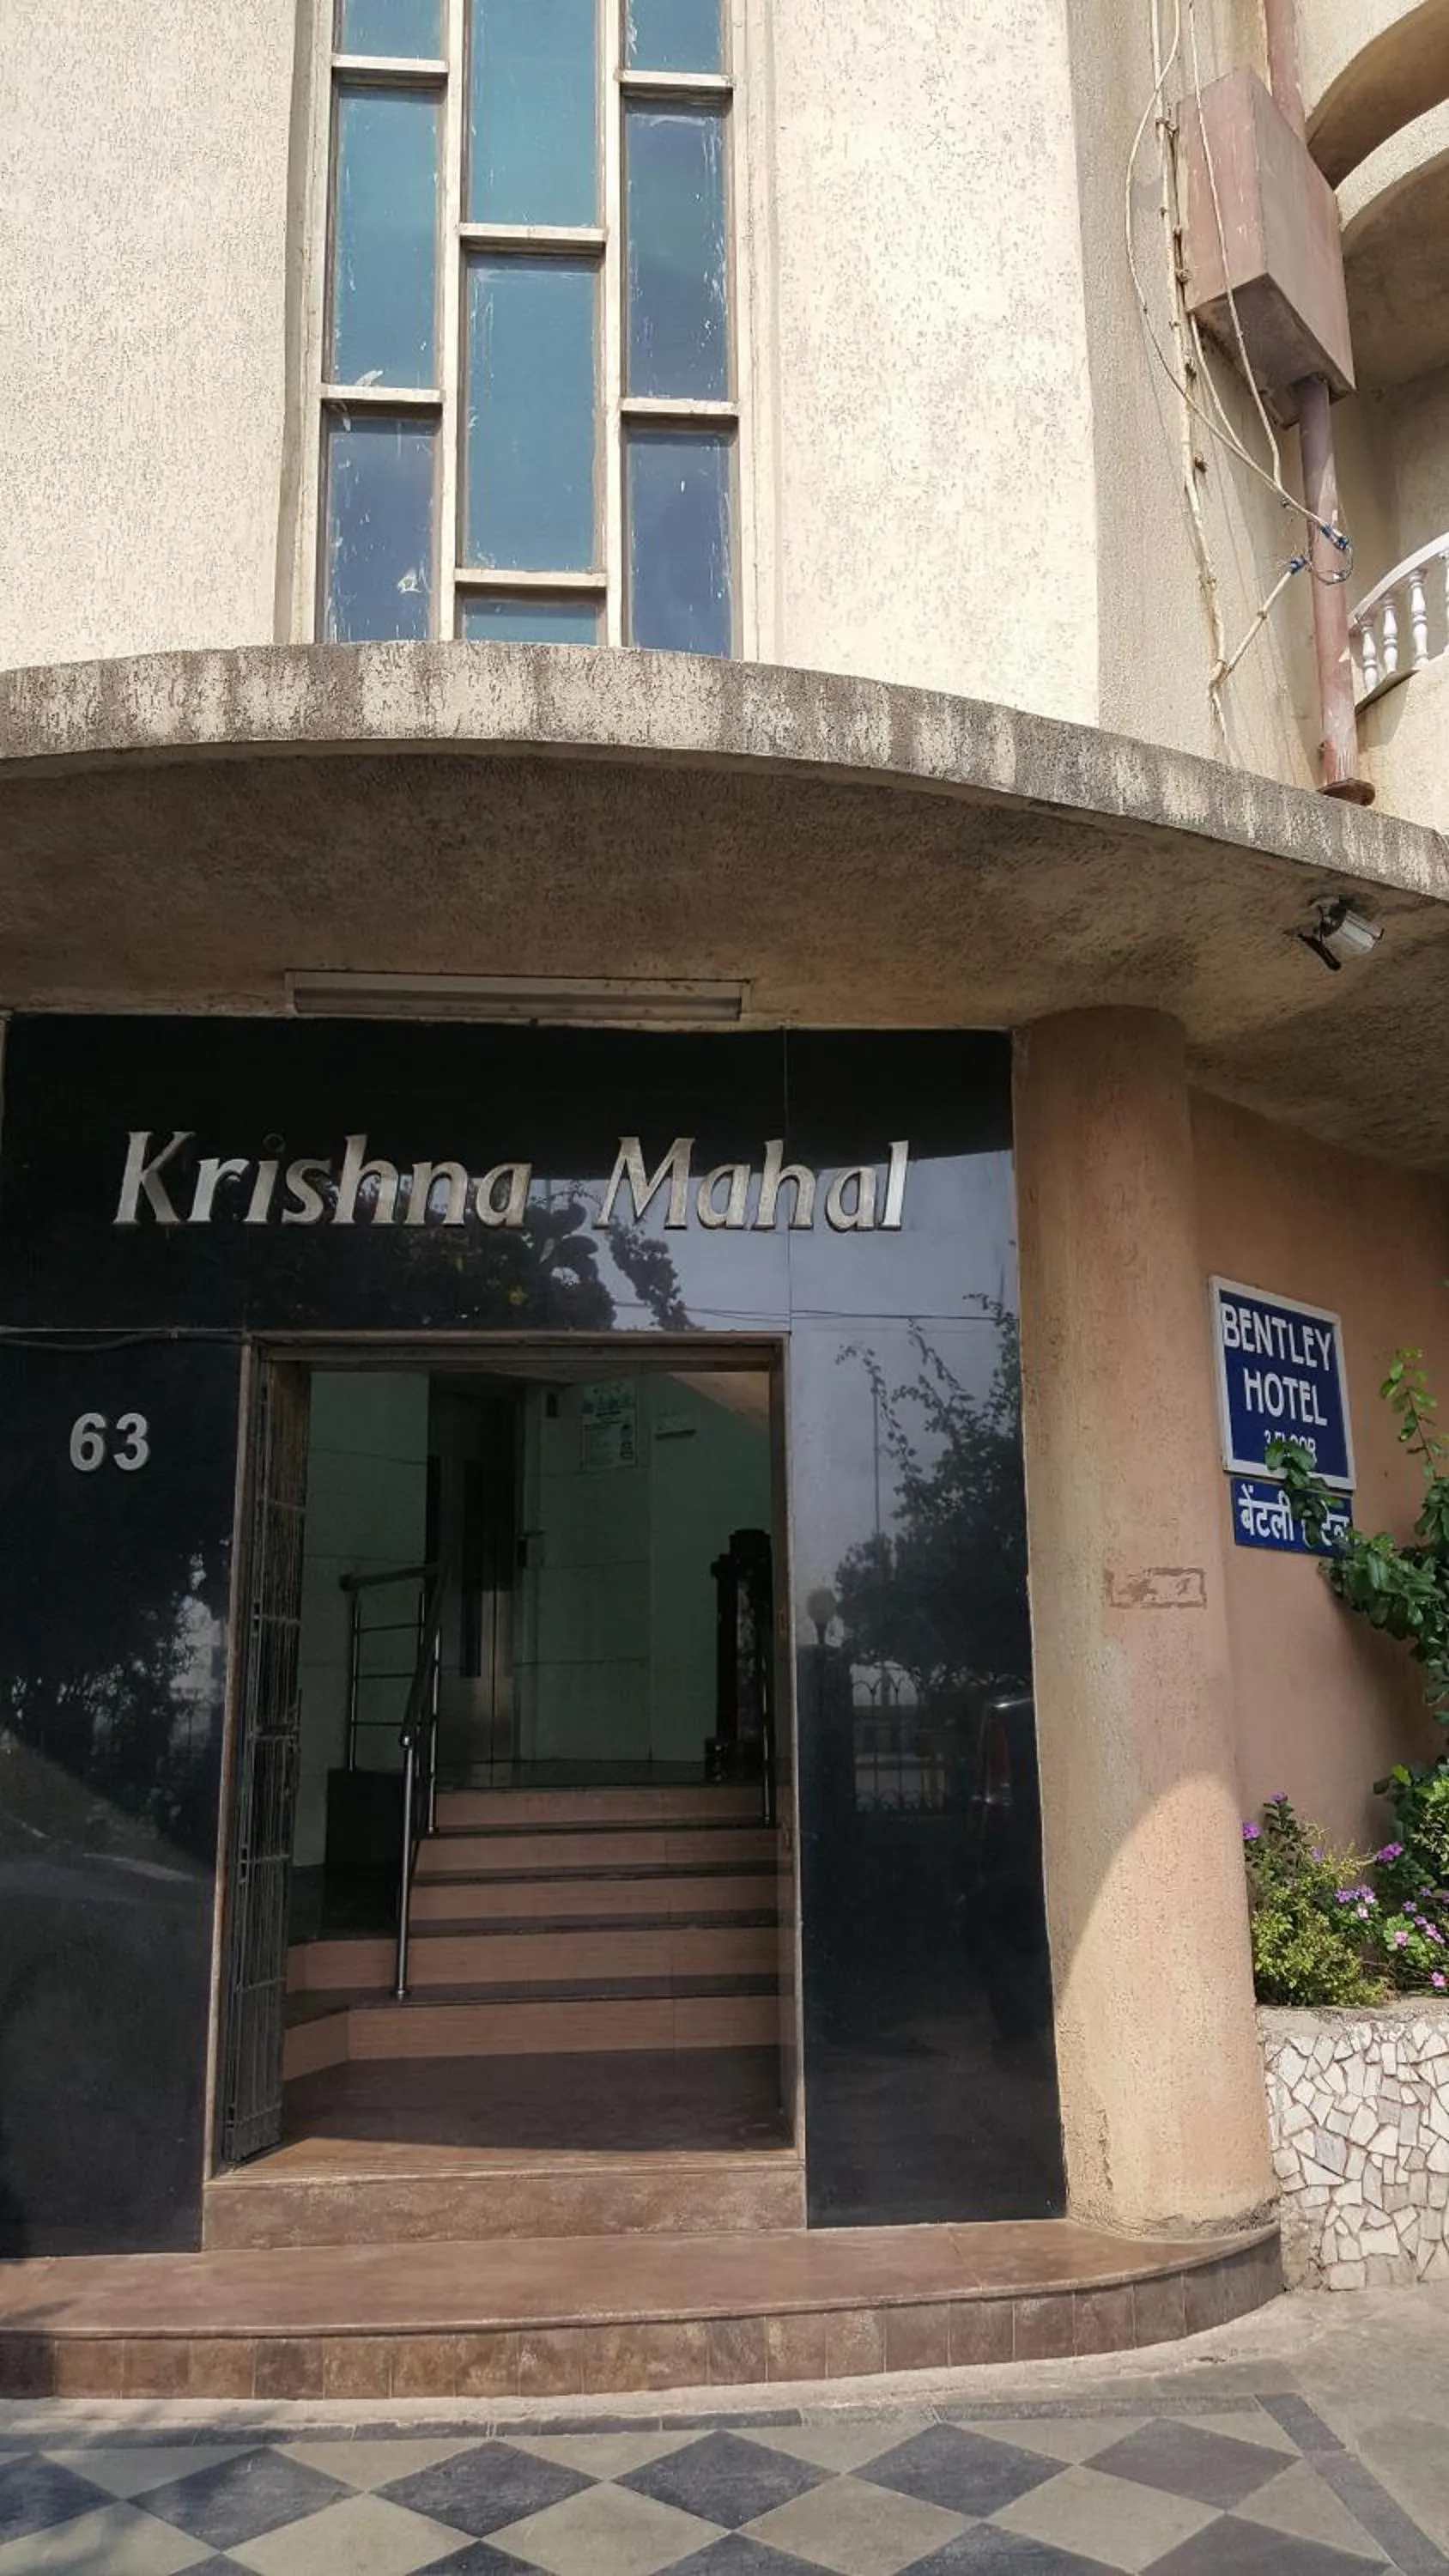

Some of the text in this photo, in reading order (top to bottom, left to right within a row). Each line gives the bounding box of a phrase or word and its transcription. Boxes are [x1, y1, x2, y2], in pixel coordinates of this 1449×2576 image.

[113, 1131, 910, 1231] Krishna Mahal
[1220, 1302, 1331, 1371] BENTLEY
[1243, 1367, 1328, 1426] HOTEL
[70, 1412, 149, 1471] 63
